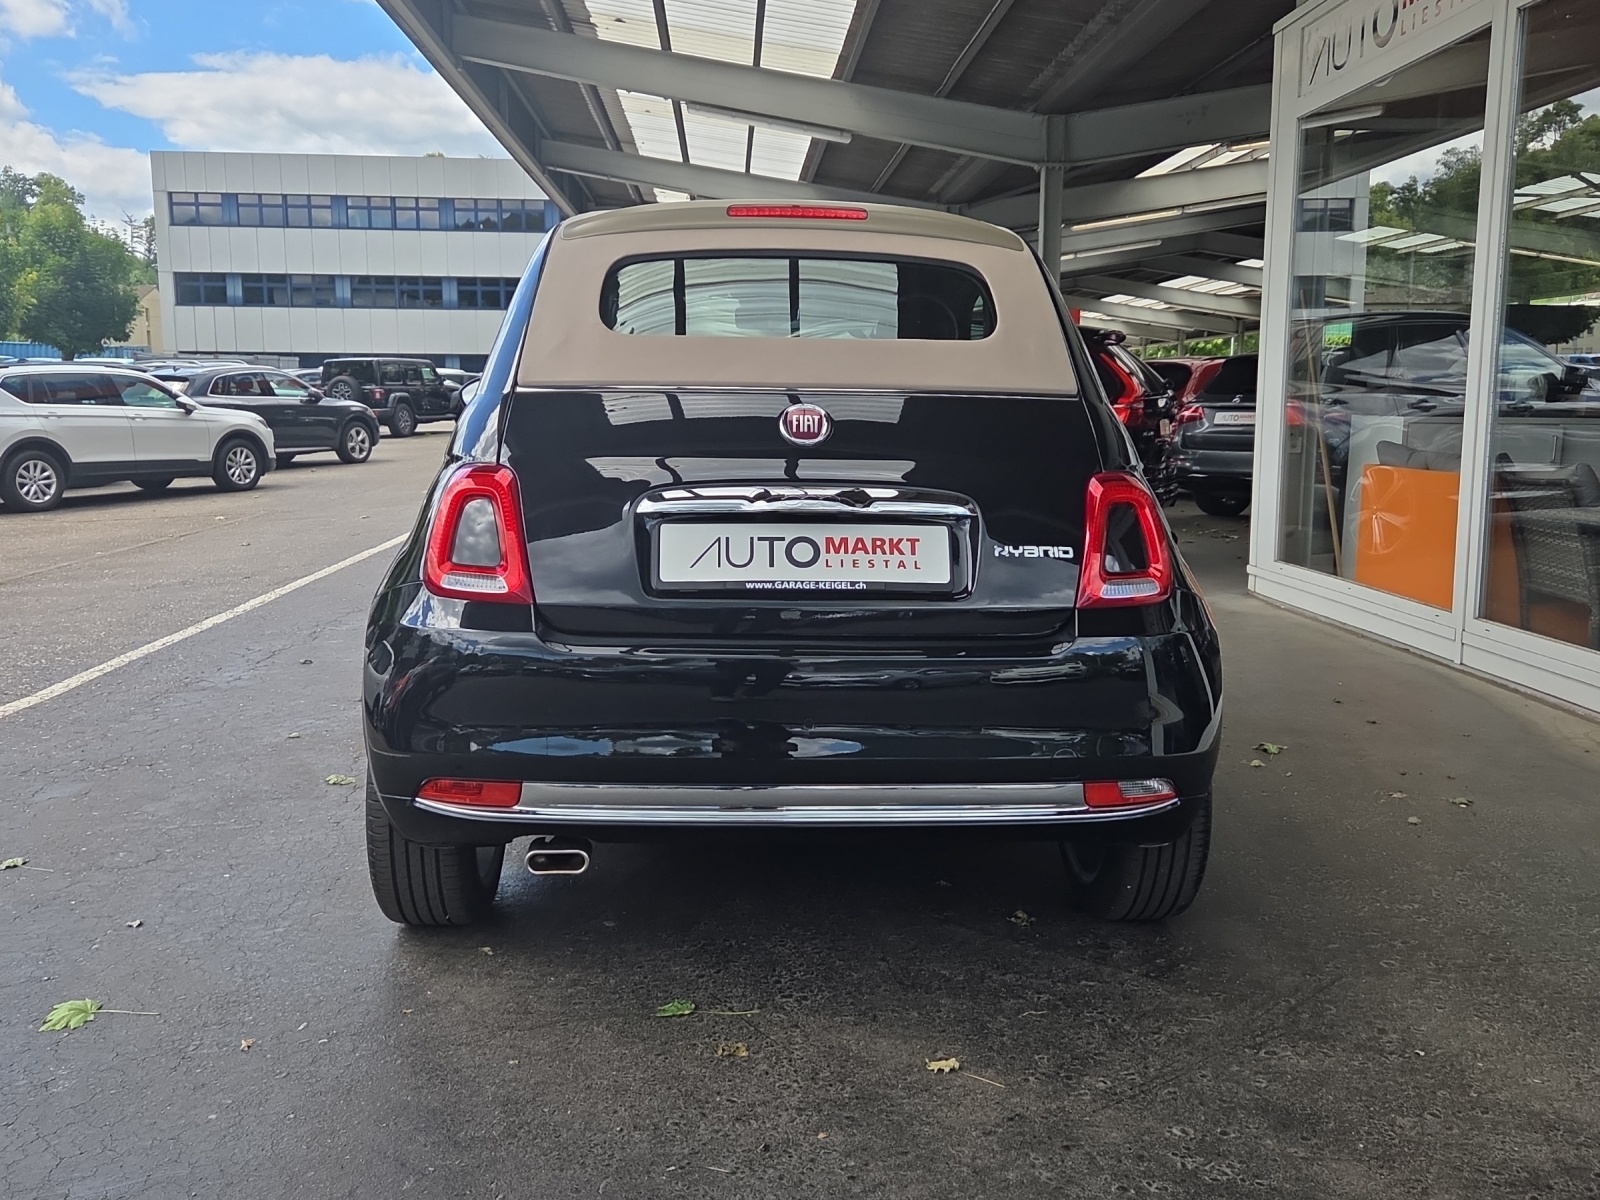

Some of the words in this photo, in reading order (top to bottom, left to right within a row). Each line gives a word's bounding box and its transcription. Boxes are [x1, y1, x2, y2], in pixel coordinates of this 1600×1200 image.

[1400, 0, 1464, 37] LIES
[792, 414, 821, 433] FIAT
[689, 536, 821, 569] AUTO
[825, 536, 920, 556] MARKT
[993, 545, 1074, 559] HYBRID
[825, 558, 921, 570] LIESTAL
[745, 581, 867, 591] www.GARAGE-KEIGEL.ch
